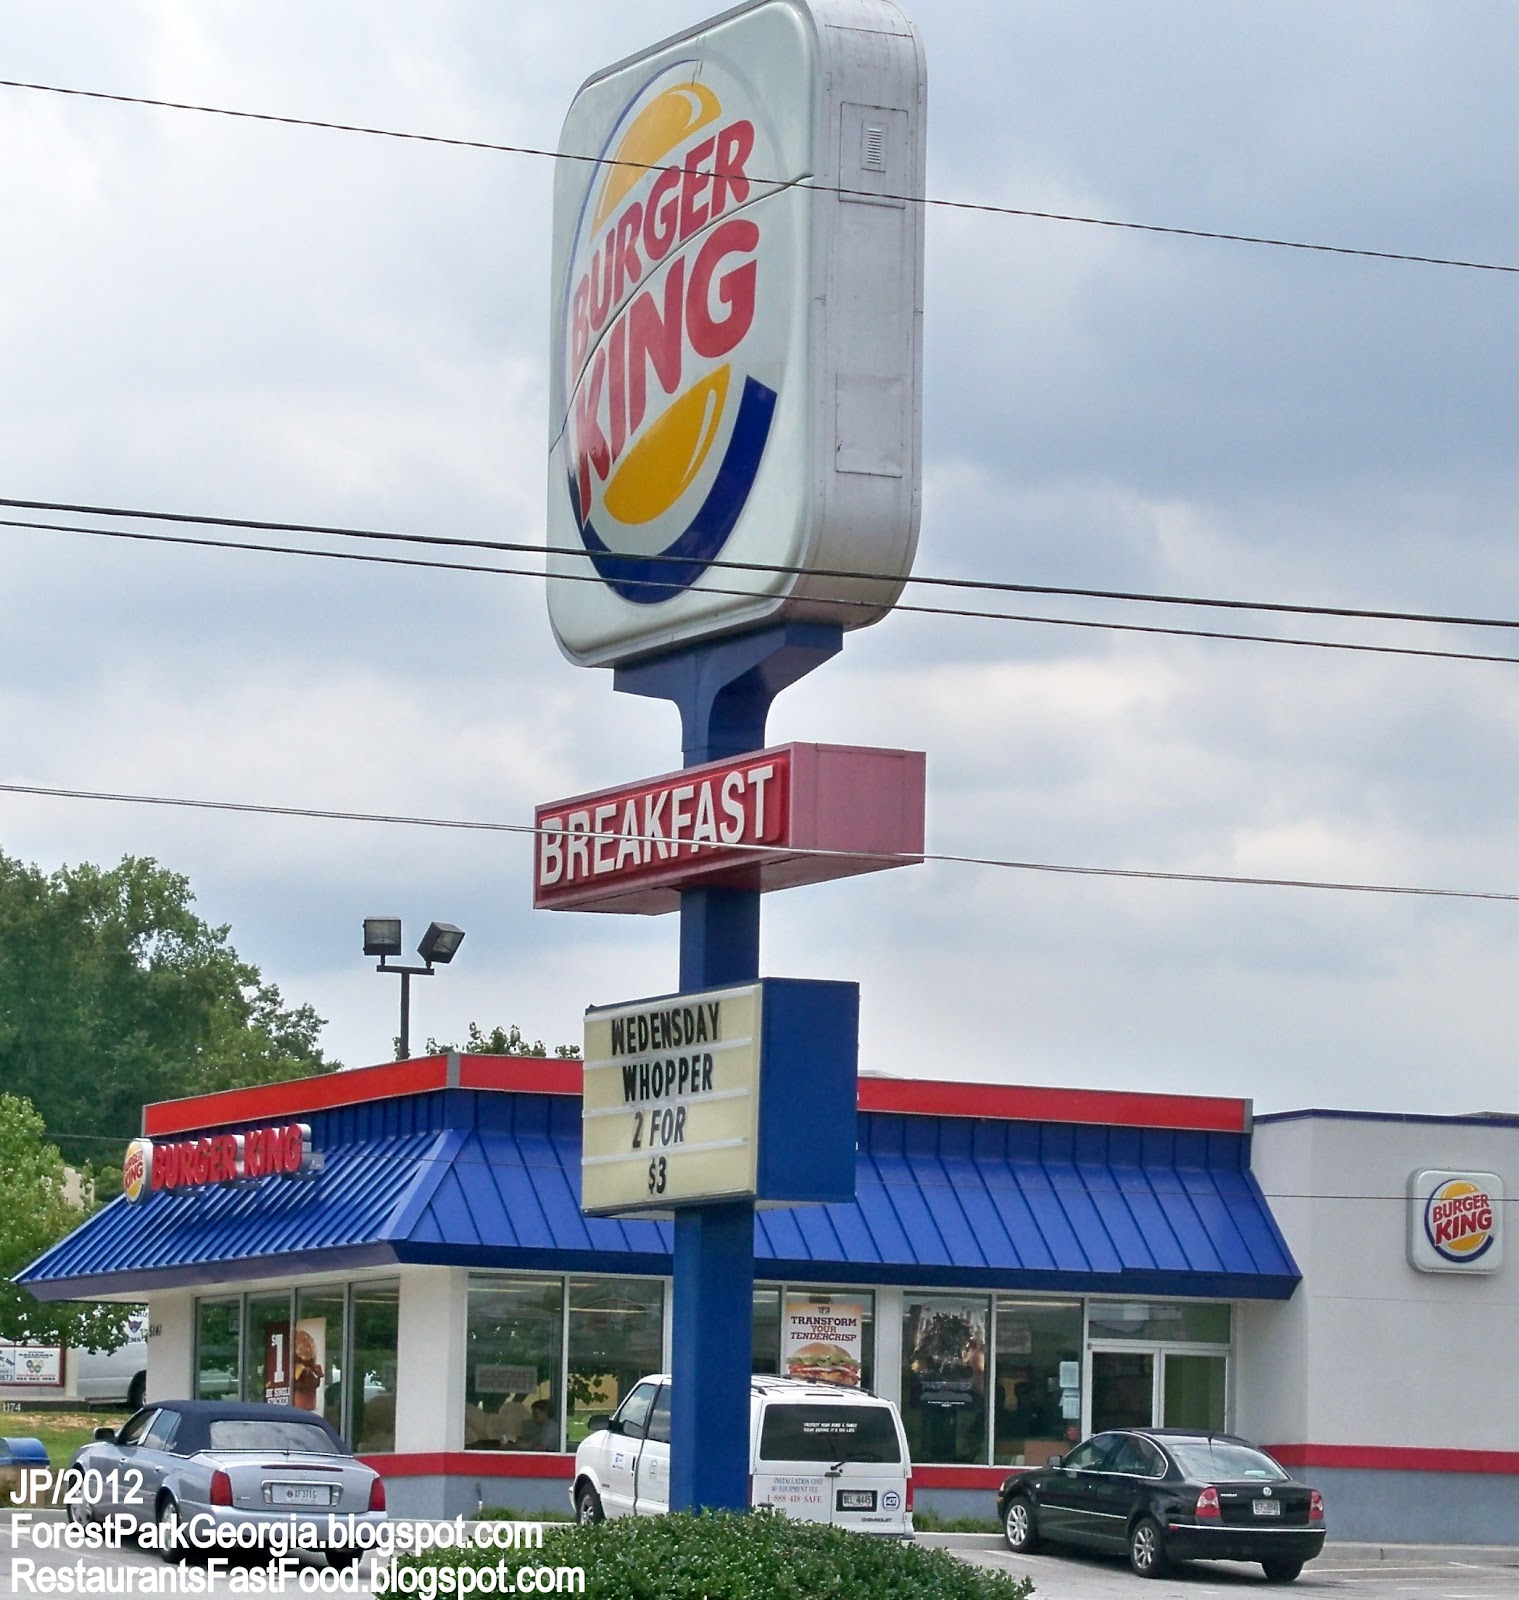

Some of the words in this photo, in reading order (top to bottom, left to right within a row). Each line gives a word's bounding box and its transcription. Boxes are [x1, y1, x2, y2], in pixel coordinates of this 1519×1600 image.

[572, 119, 755, 386] BURGER
[575, 219, 760, 528] KING
[540, 765, 774, 887] BREAKFAST
[611, 1002, 720, 1056] WEDENSDAY
[622, 1053, 713, 1102] WHOPPER
[632, 1111, 644, 1149] 2
[649, 1106, 687, 1147] FOR
[125, 1150, 143, 1173] BURGER
[125, 1161, 143, 1188] KING
[152, 1134, 238, 1191] BURGER
[244, 1122, 302, 1177] KING
[648, 1155, 667, 1195] $3
[1432, 1194, 1490, 1223] BURGER
[1435, 1208, 1492, 1245] KING
[790, 1316, 857, 1327] TRANSFORM
[790, 1332, 857, 1342] TENDERCRISP
[811, 1325, 837, 1333] YOUR
